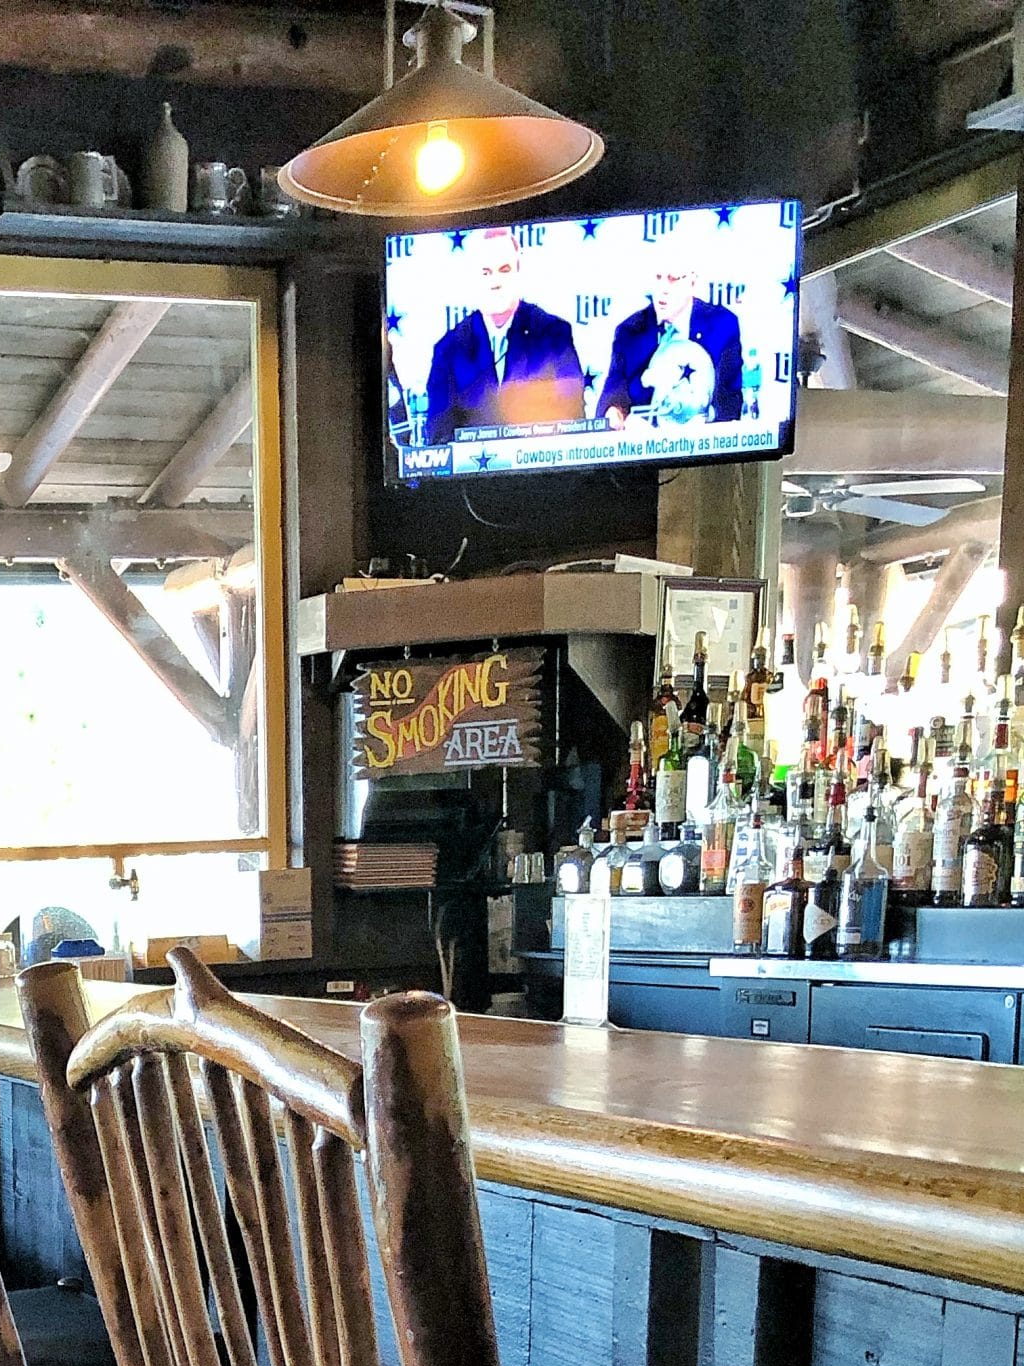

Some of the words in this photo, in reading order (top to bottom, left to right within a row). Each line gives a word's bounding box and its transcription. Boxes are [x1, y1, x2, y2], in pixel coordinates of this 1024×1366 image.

[512, 223, 546, 249] ite
[643, 213, 680, 243] Lite
[386, 235, 415, 266] ite
[576, 294, 612, 326] Lite
[516, 448, 563, 465] Cowboys
[565, 444, 615, 460] introduce
[618, 441, 643, 456] Mike
[645, 437, 695, 454] McCarthy
[698, 438, 710, 450] as
[713, 433, 738, 449] head
[741, 430, 773, 447] coach
[369, 669, 413, 699] NO
[363, 654, 510, 768] SMOKING
[444, 724, 523, 760] AREA
